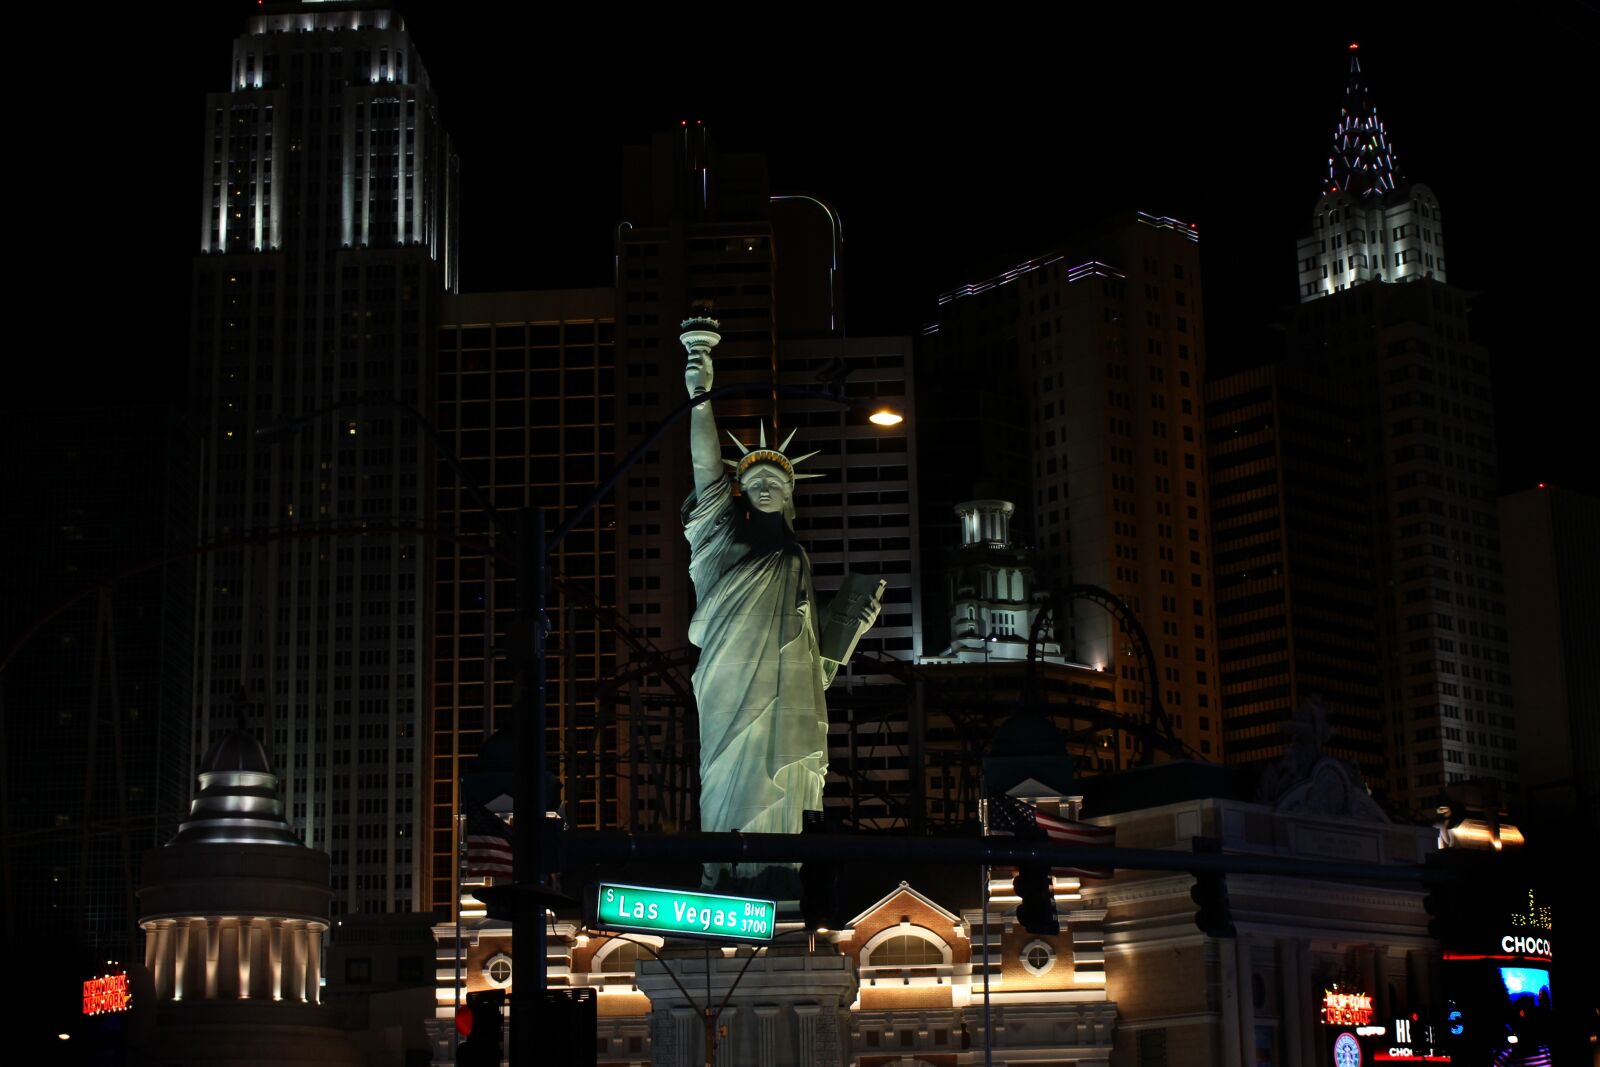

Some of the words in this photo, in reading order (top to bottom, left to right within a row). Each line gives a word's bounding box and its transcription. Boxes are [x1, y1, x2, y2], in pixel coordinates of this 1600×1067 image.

[607, 888, 615, 903] S
[618, 895, 659, 920] Las
[673, 900, 737, 931] Vegas
[744, 902, 766, 918] Blvd
[740, 918, 767, 934] 3700
[1501, 935, 1552, 957] CHOCO
[83, 978, 102, 995] NEW
[102, 974, 126, 991] YORK
[83, 995, 102, 1014] NEW
[102, 991, 126, 1008] YORK
